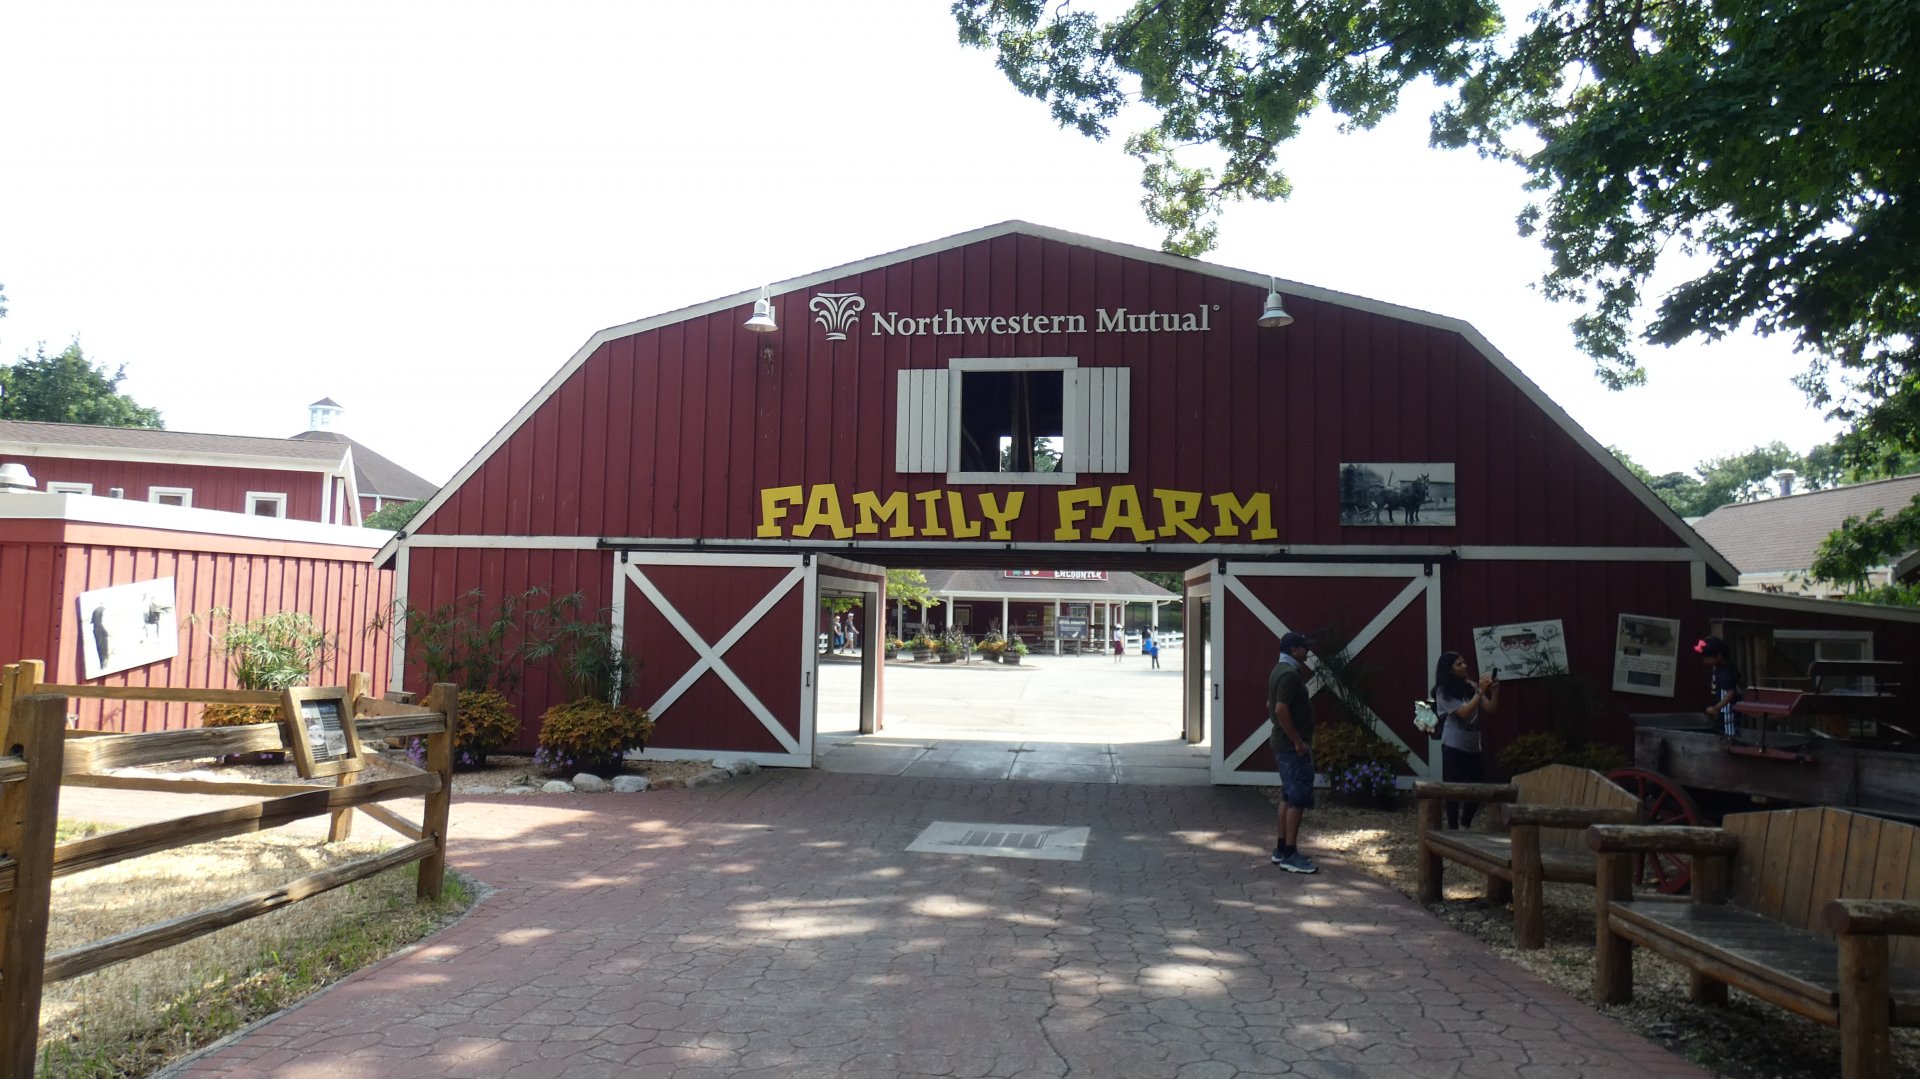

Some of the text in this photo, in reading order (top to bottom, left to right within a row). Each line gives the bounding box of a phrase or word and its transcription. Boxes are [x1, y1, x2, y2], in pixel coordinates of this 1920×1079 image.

[871, 308, 1088, 337] Northwestern
[757, 483, 1278, 543] FAMILY FARM
[1054, 570, 1102, 579] ENCOUNTER
